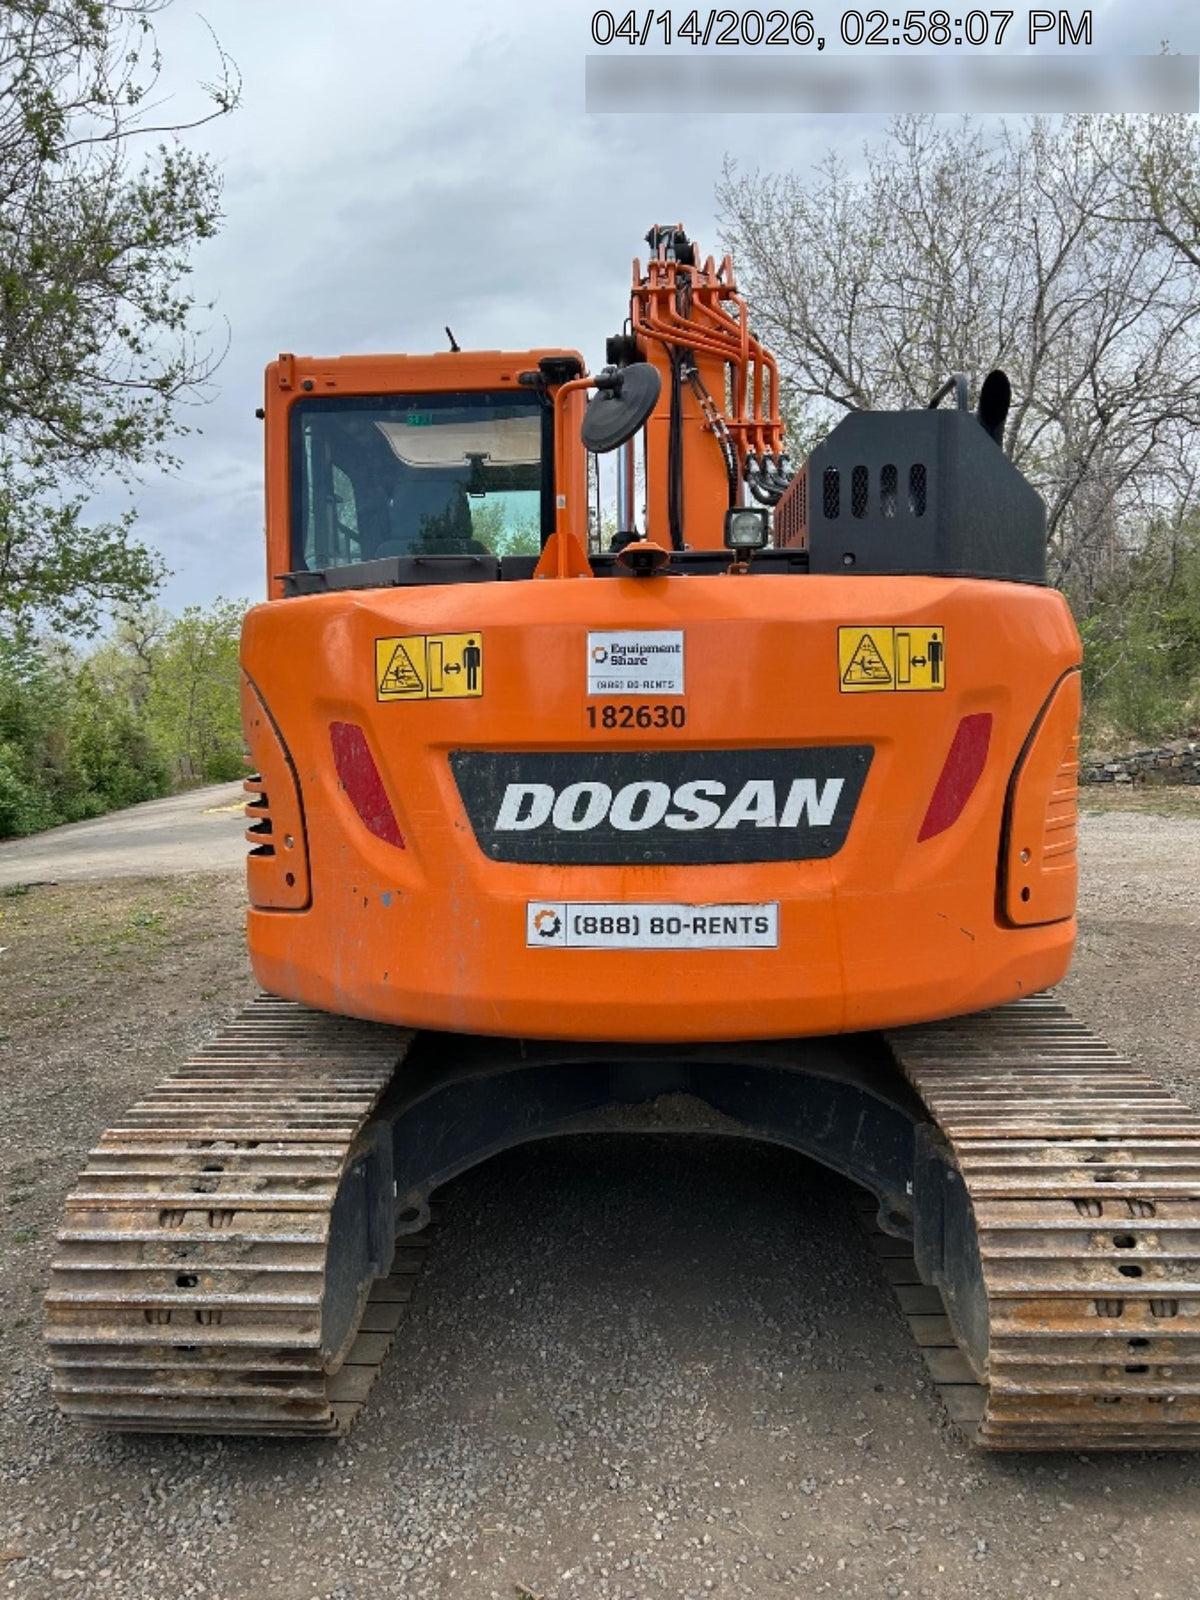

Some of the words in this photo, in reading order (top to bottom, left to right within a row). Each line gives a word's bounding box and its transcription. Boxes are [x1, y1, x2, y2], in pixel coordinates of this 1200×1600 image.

[610, 643, 681, 656] Equipment
[610, 656, 648, 666] Share
[586, 705, 686, 728] 182630
[494, 778, 845, 831] DOOSAN
[574, 915, 640, 936] (888)
[650, 915, 769, 935] 80-RENTS
